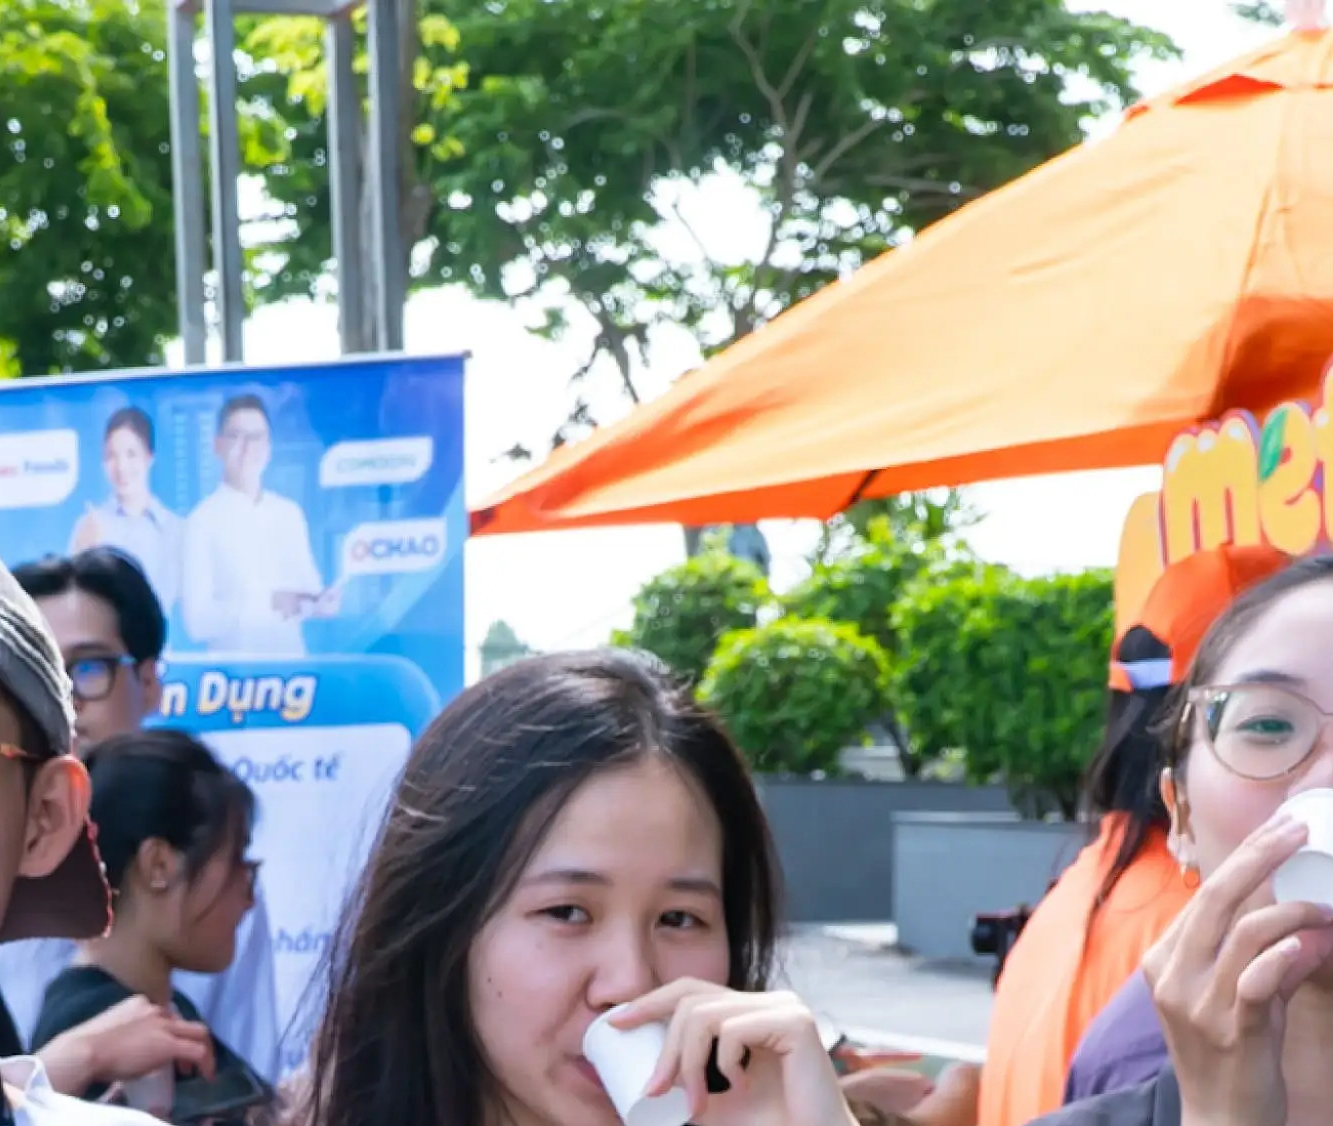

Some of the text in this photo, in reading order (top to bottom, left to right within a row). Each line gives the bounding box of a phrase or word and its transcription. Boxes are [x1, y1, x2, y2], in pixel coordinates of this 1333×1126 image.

[198, 670, 317, 723] Dụng
[234, 751, 345, 781] Quốc tế
